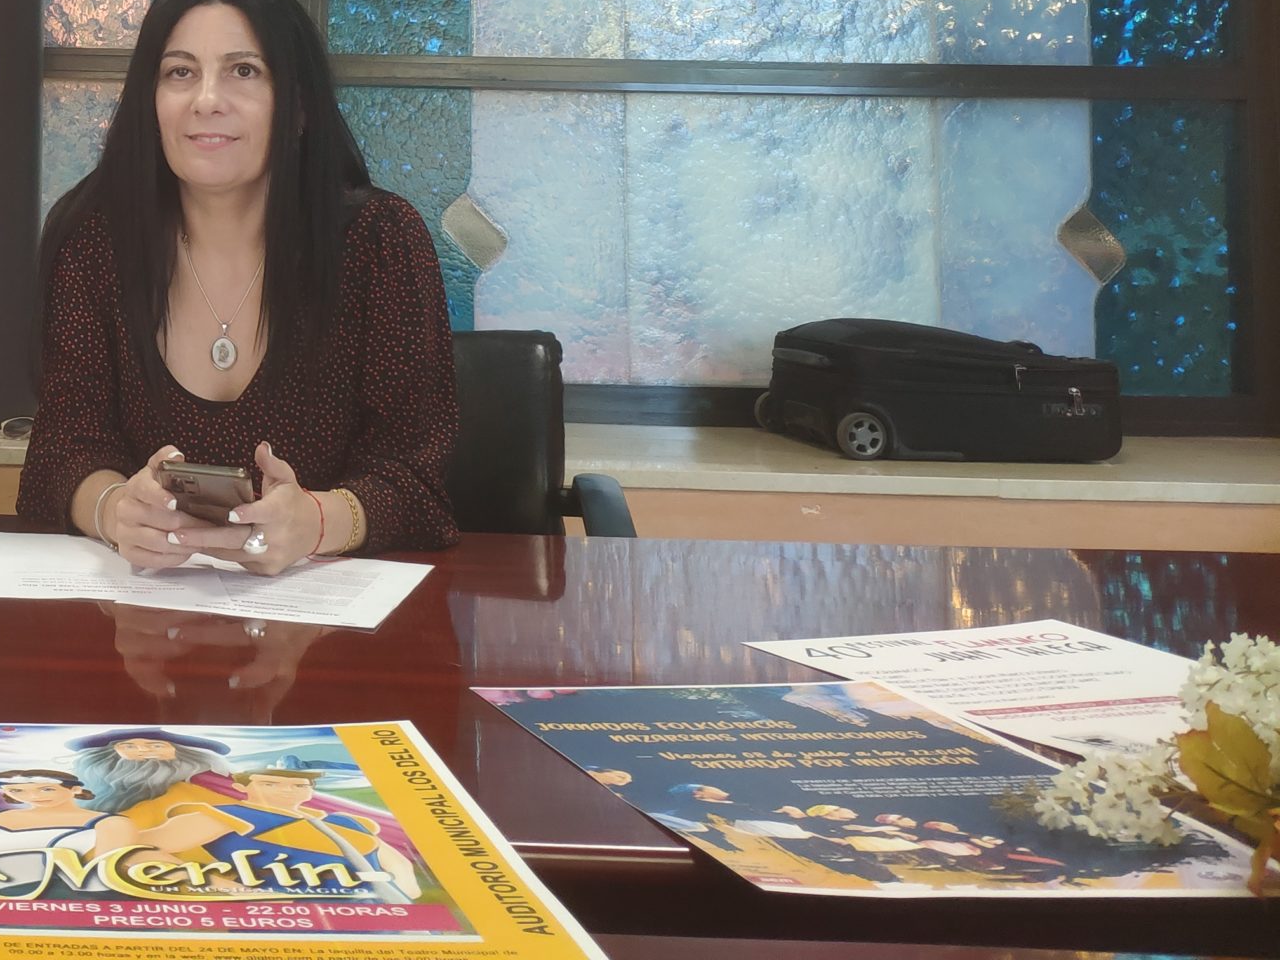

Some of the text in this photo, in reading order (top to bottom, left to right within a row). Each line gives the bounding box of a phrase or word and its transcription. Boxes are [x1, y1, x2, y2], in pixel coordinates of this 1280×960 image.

[933, 633, 1070, 649] FLAMENCO
[925, 647, 1003, 666] JUAN
[534, 721, 651, 732] JORNADAS
[609, 730, 928, 744] NAZARENAS INTERNACIONALES
[657, 751, 737, 761] Viernes
[771, 750, 797, 758] de
[798, 749, 851, 760] julio
[871, 749, 906, 757] las
[690, 758, 796, 770] ENTRADA
[797, 758, 852, 769] POR
[371, 729, 556, 936] AUDITORIO MUNICIPAL LOS DEL RÍO
[150, 885, 180, 893] UN
[186, 885, 275, 894] MUSICAL
[109, 904, 124, 913] 3
[131, 904, 208, 915] JUNIO
[246, 905, 311, 916] 22.00
[319, 906, 410, 917] HORAS
[94, 915, 314, 929] PRECIO 5 EUROS
[25, 942, 99, 951] ENTRADAS
[441, 949, 499, 957] Municipal
